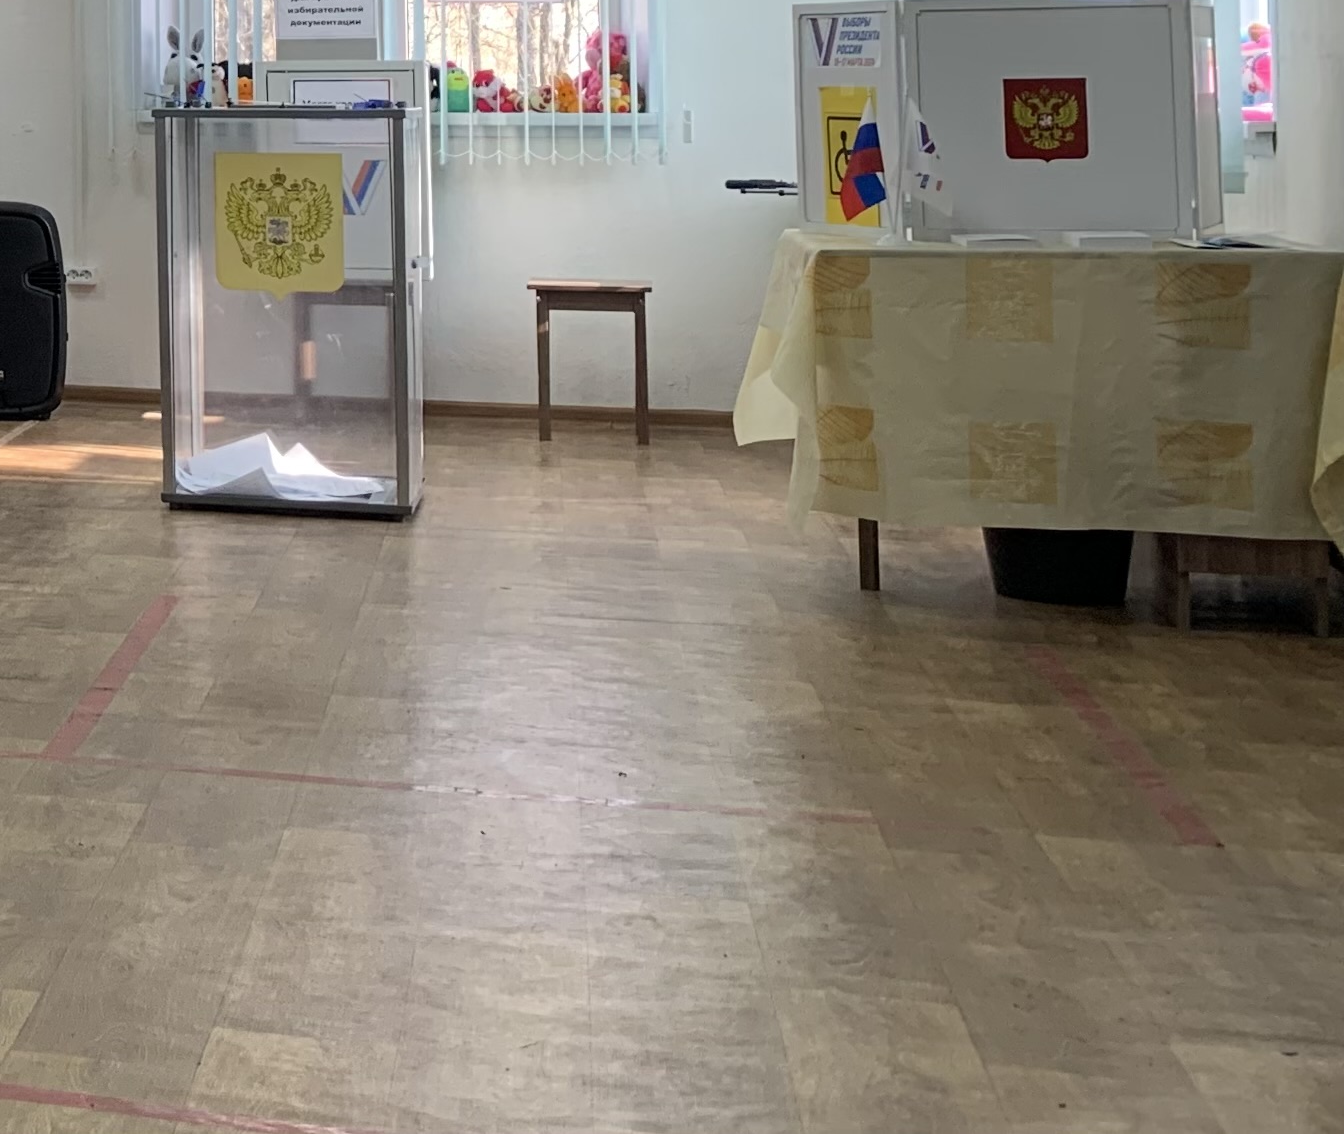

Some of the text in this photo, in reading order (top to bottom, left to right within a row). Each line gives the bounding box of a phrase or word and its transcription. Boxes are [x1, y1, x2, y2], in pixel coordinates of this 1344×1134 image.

[287, 6, 363, 15] избирательной
[290, 19, 361, 27] документации
[842, 16, 872, 28] ВЫБОРЫ
[839, 30, 880, 41] ПРЕЗИДЕНТА
